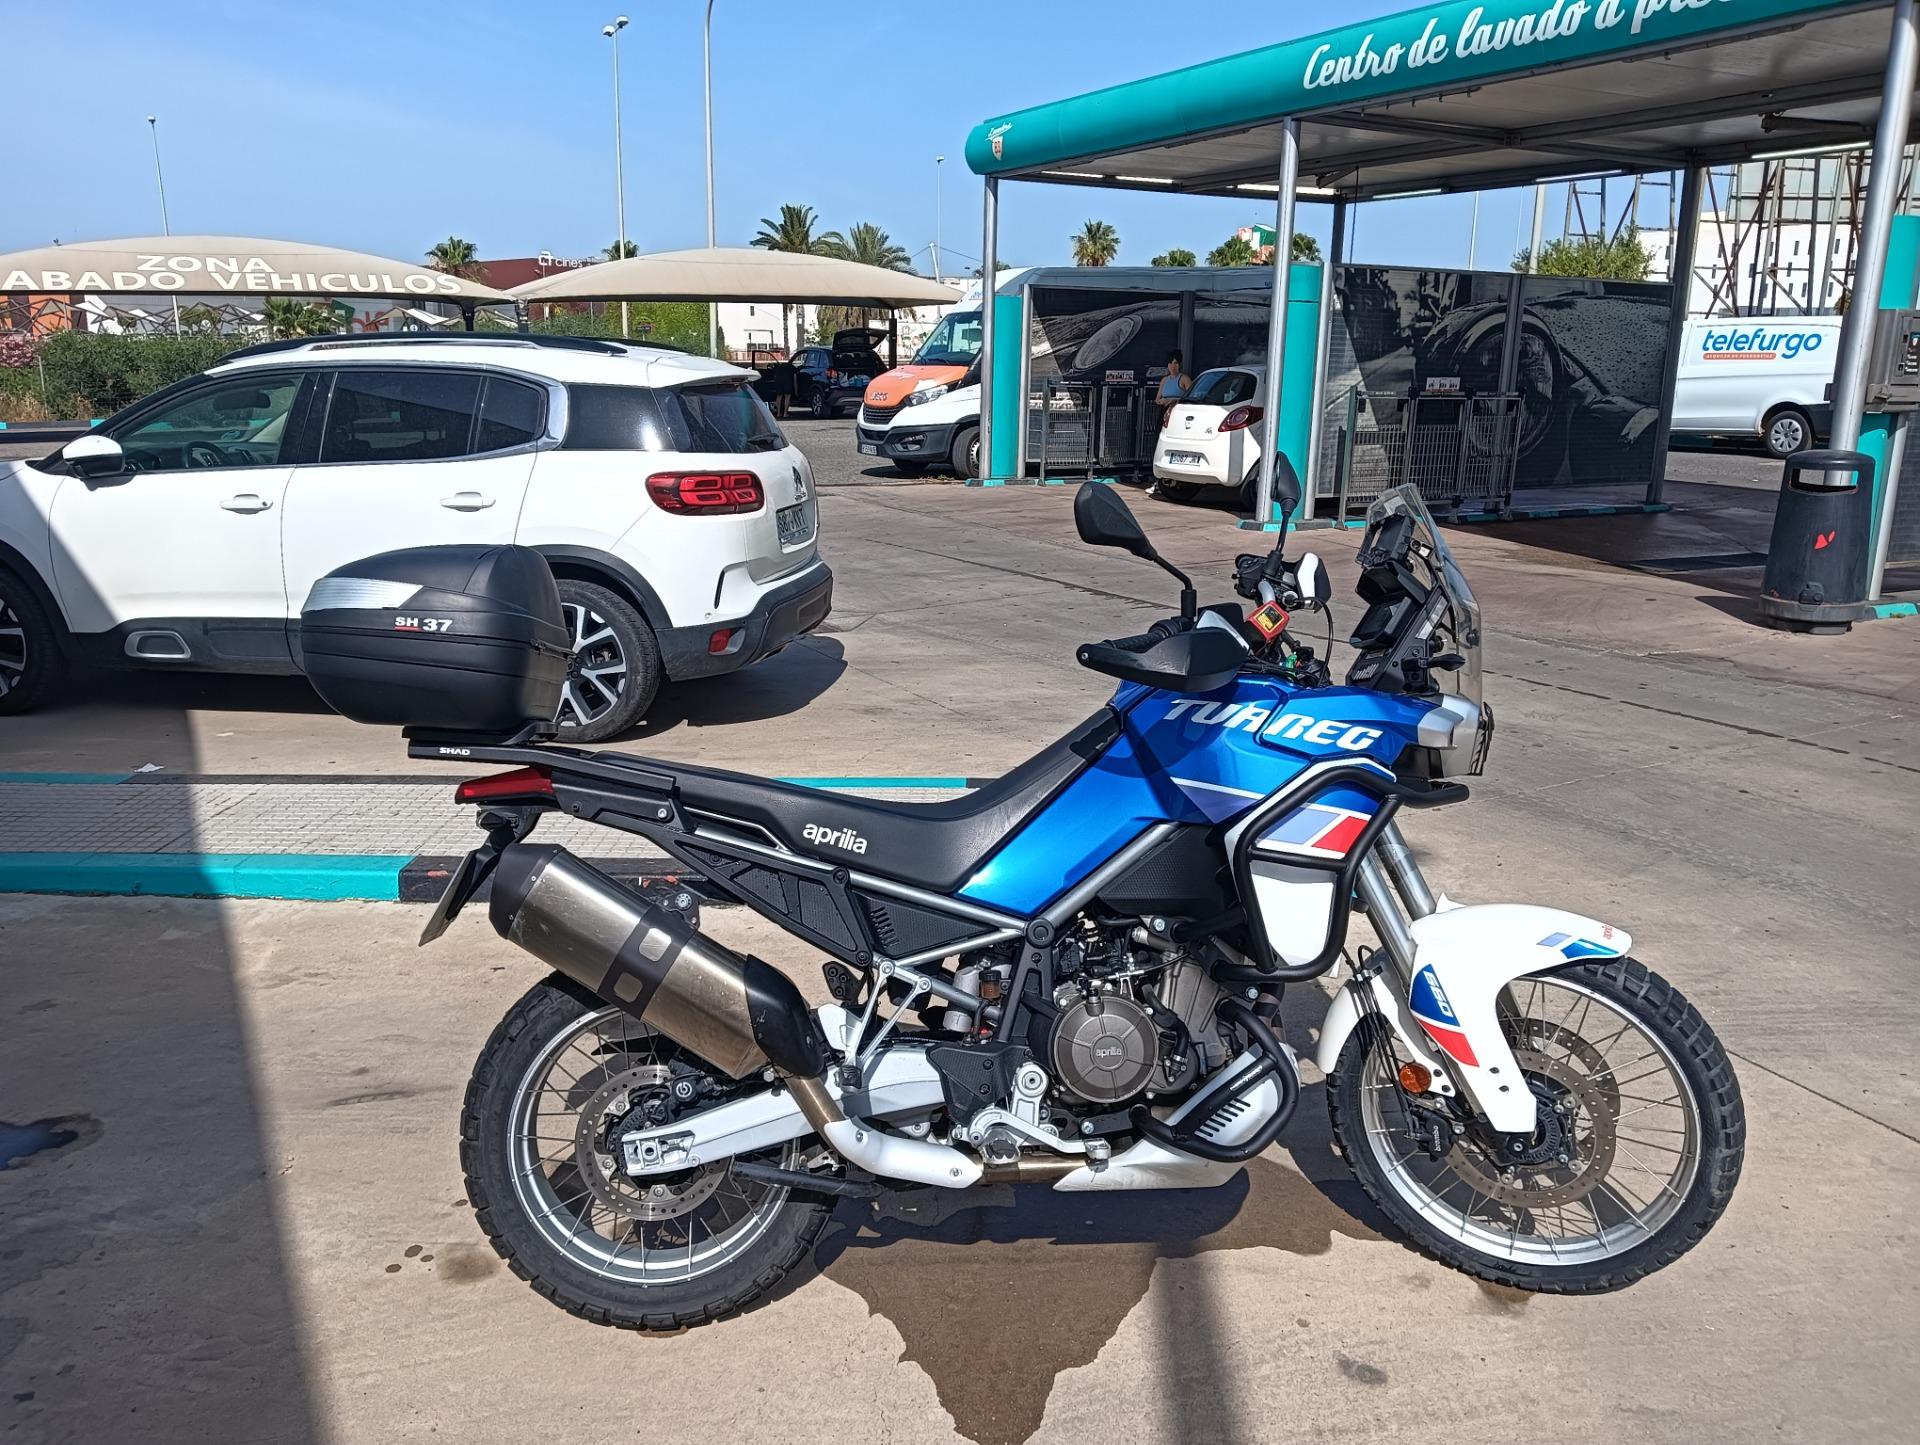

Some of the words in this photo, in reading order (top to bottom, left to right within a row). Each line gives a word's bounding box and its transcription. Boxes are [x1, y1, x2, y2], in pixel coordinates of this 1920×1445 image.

[1302, 33, 1405, 90] Centro
[1407, 17, 1449, 69] de
[1455, 0, 1591, 58] lavado
[136, 255, 277, 273] ZONA
[555, 256, 583, 268] cines
[209, 271, 462, 294] VEHICULOS
[1702, 328, 1822, 360] telefurgo
[394, 616, 419, 627] SH
[422, 618, 453, 632] 37
[1163, 699, 1383, 750] TUAREG
[439, 747, 470, 756] SHAD
[802, 823, 868, 855] aprilia
[1422, 969, 1455, 1018] 660
[1096, 1046, 1122, 1059] aprilia
[1433, 1125, 1441, 1152] brembo
